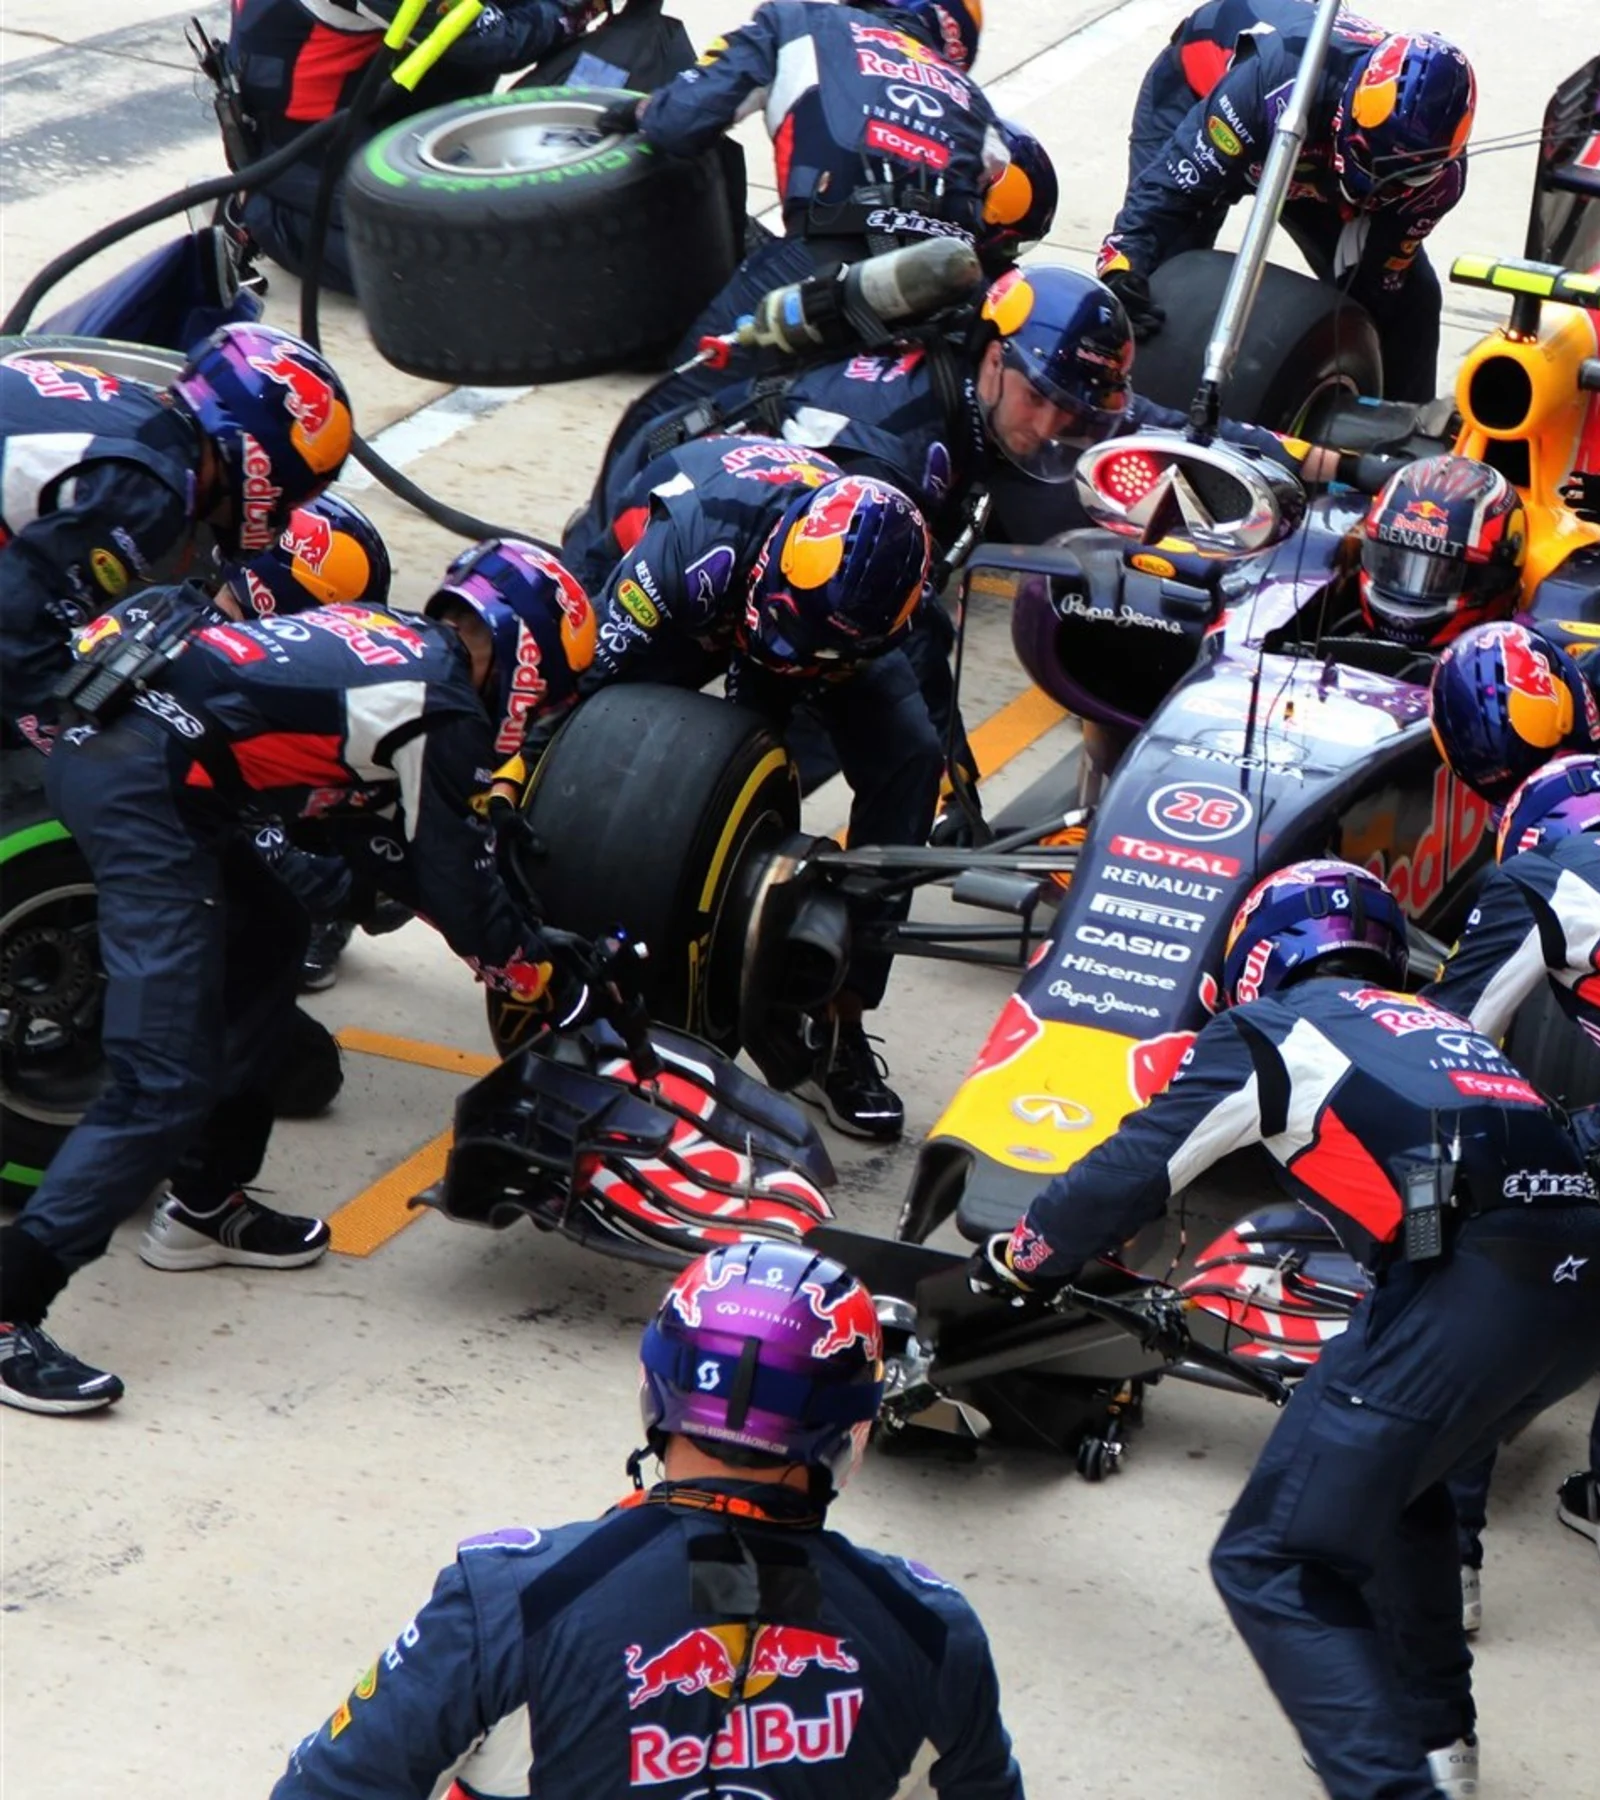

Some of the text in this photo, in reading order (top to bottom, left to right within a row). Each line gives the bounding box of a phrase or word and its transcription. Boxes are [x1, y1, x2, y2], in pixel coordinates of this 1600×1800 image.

[862, 103, 957, 149] INFINITI
[871, 126, 943, 164] TOTAL
[1379, 524, 1465, 557] RENAULT
[635, 560, 673, 619] RENAULT
[1061, 593, 1184, 634] Pepe Jeans
[1163, 790, 1239, 830] 26
[1115, 835, 1233, 877] TOTAL
[1101, 864, 1224, 902] RENAULT
[1088, 892, 1206, 933] PIRELLI
[1075, 925, 1192, 963] CASIO
[1060, 953, 1177, 991] Hisense
[1048, 979, 1161, 1018] Pepe Jeans
[1455, 1076, 1540, 1101] TOTAL
[743, 1307, 802, 1331] INFINITI
[753, 1688, 863, 1770] Bull
